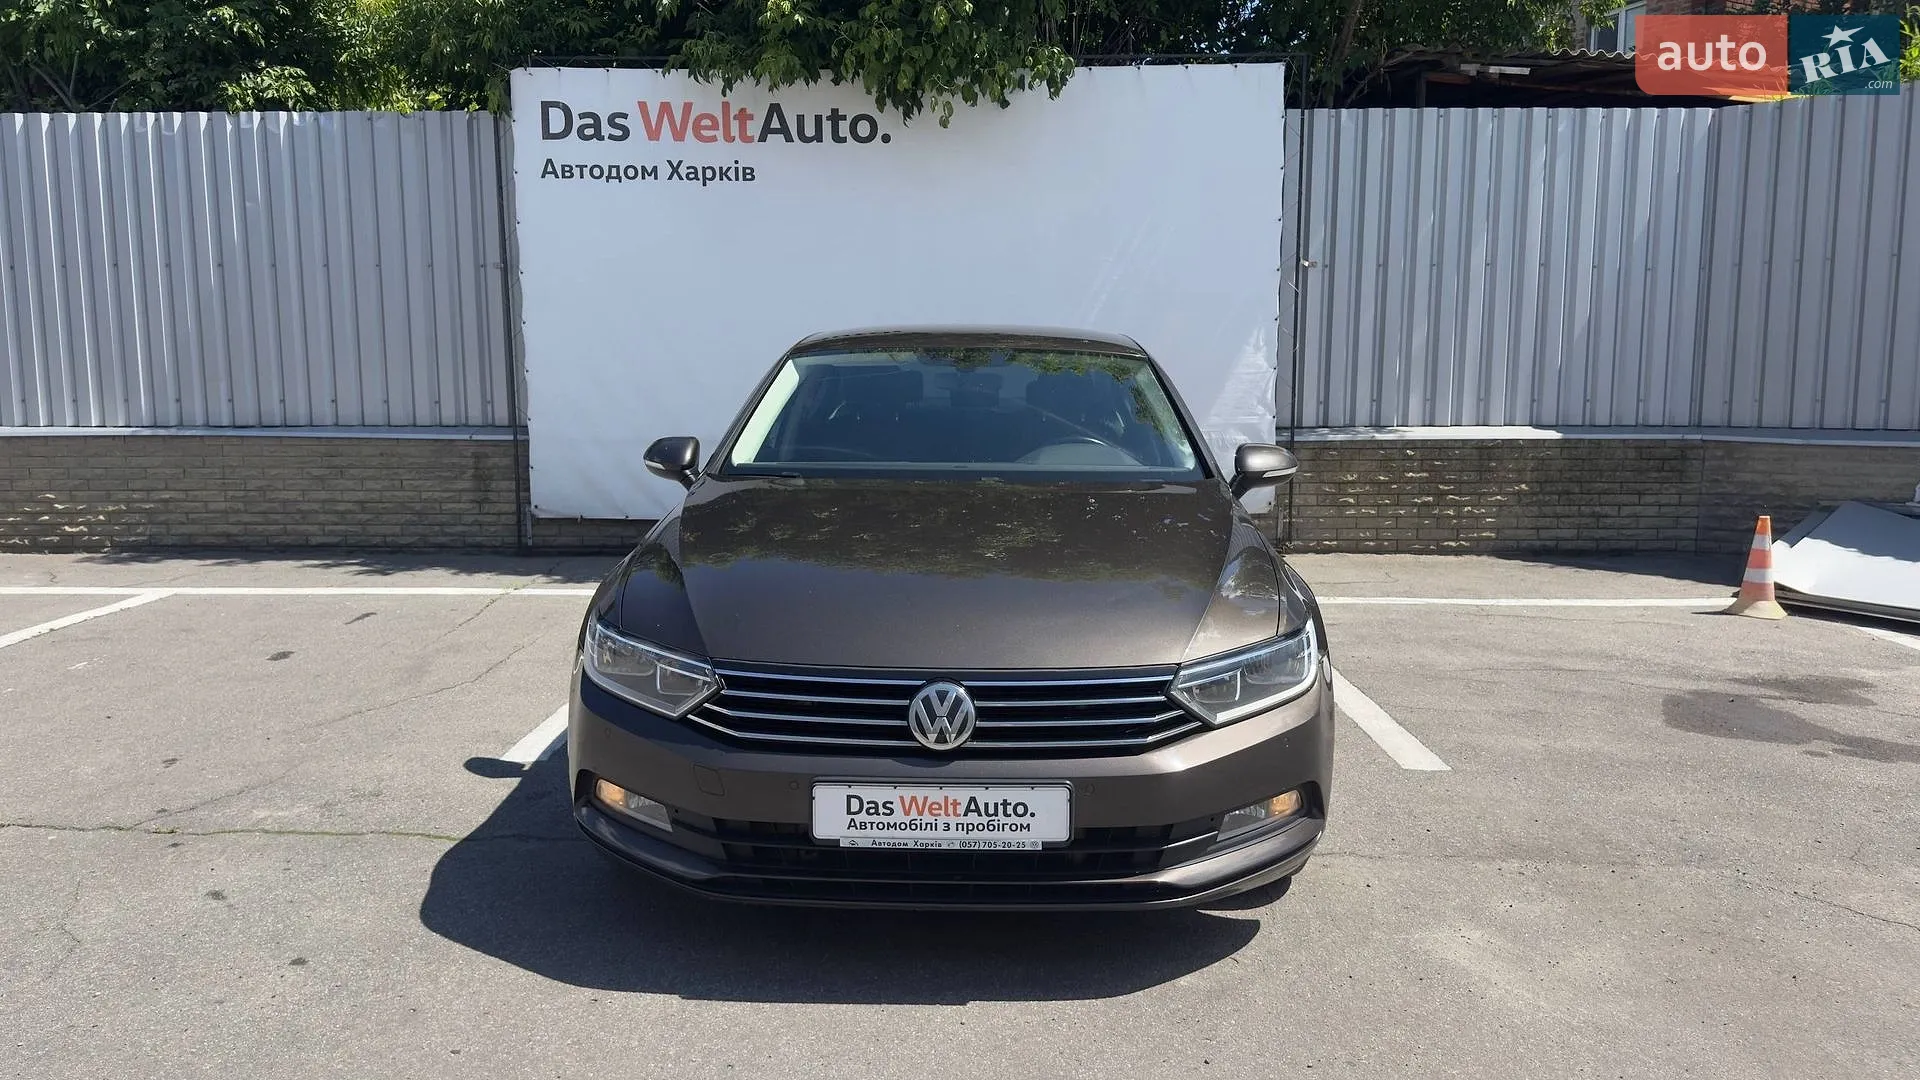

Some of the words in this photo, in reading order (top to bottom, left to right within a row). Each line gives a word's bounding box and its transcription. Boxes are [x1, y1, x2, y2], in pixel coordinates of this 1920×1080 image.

[540, 100, 630, 142] Das
[637, 100, 892, 144] WeltAuto.
[540, 158, 658, 182] Автодом
[666, 159, 756, 187] Харків
[846, 795, 895, 816] Das
[898, 796, 1036, 818] WeltAuto.
[846, 818, 939, 832] Автомобілі
[943, 823, 951, 832] з
[955, 819, 1031, 834] пробігом
[871, 839, 909, 848] Автодом
[913, 839, 942, 848] Харків
